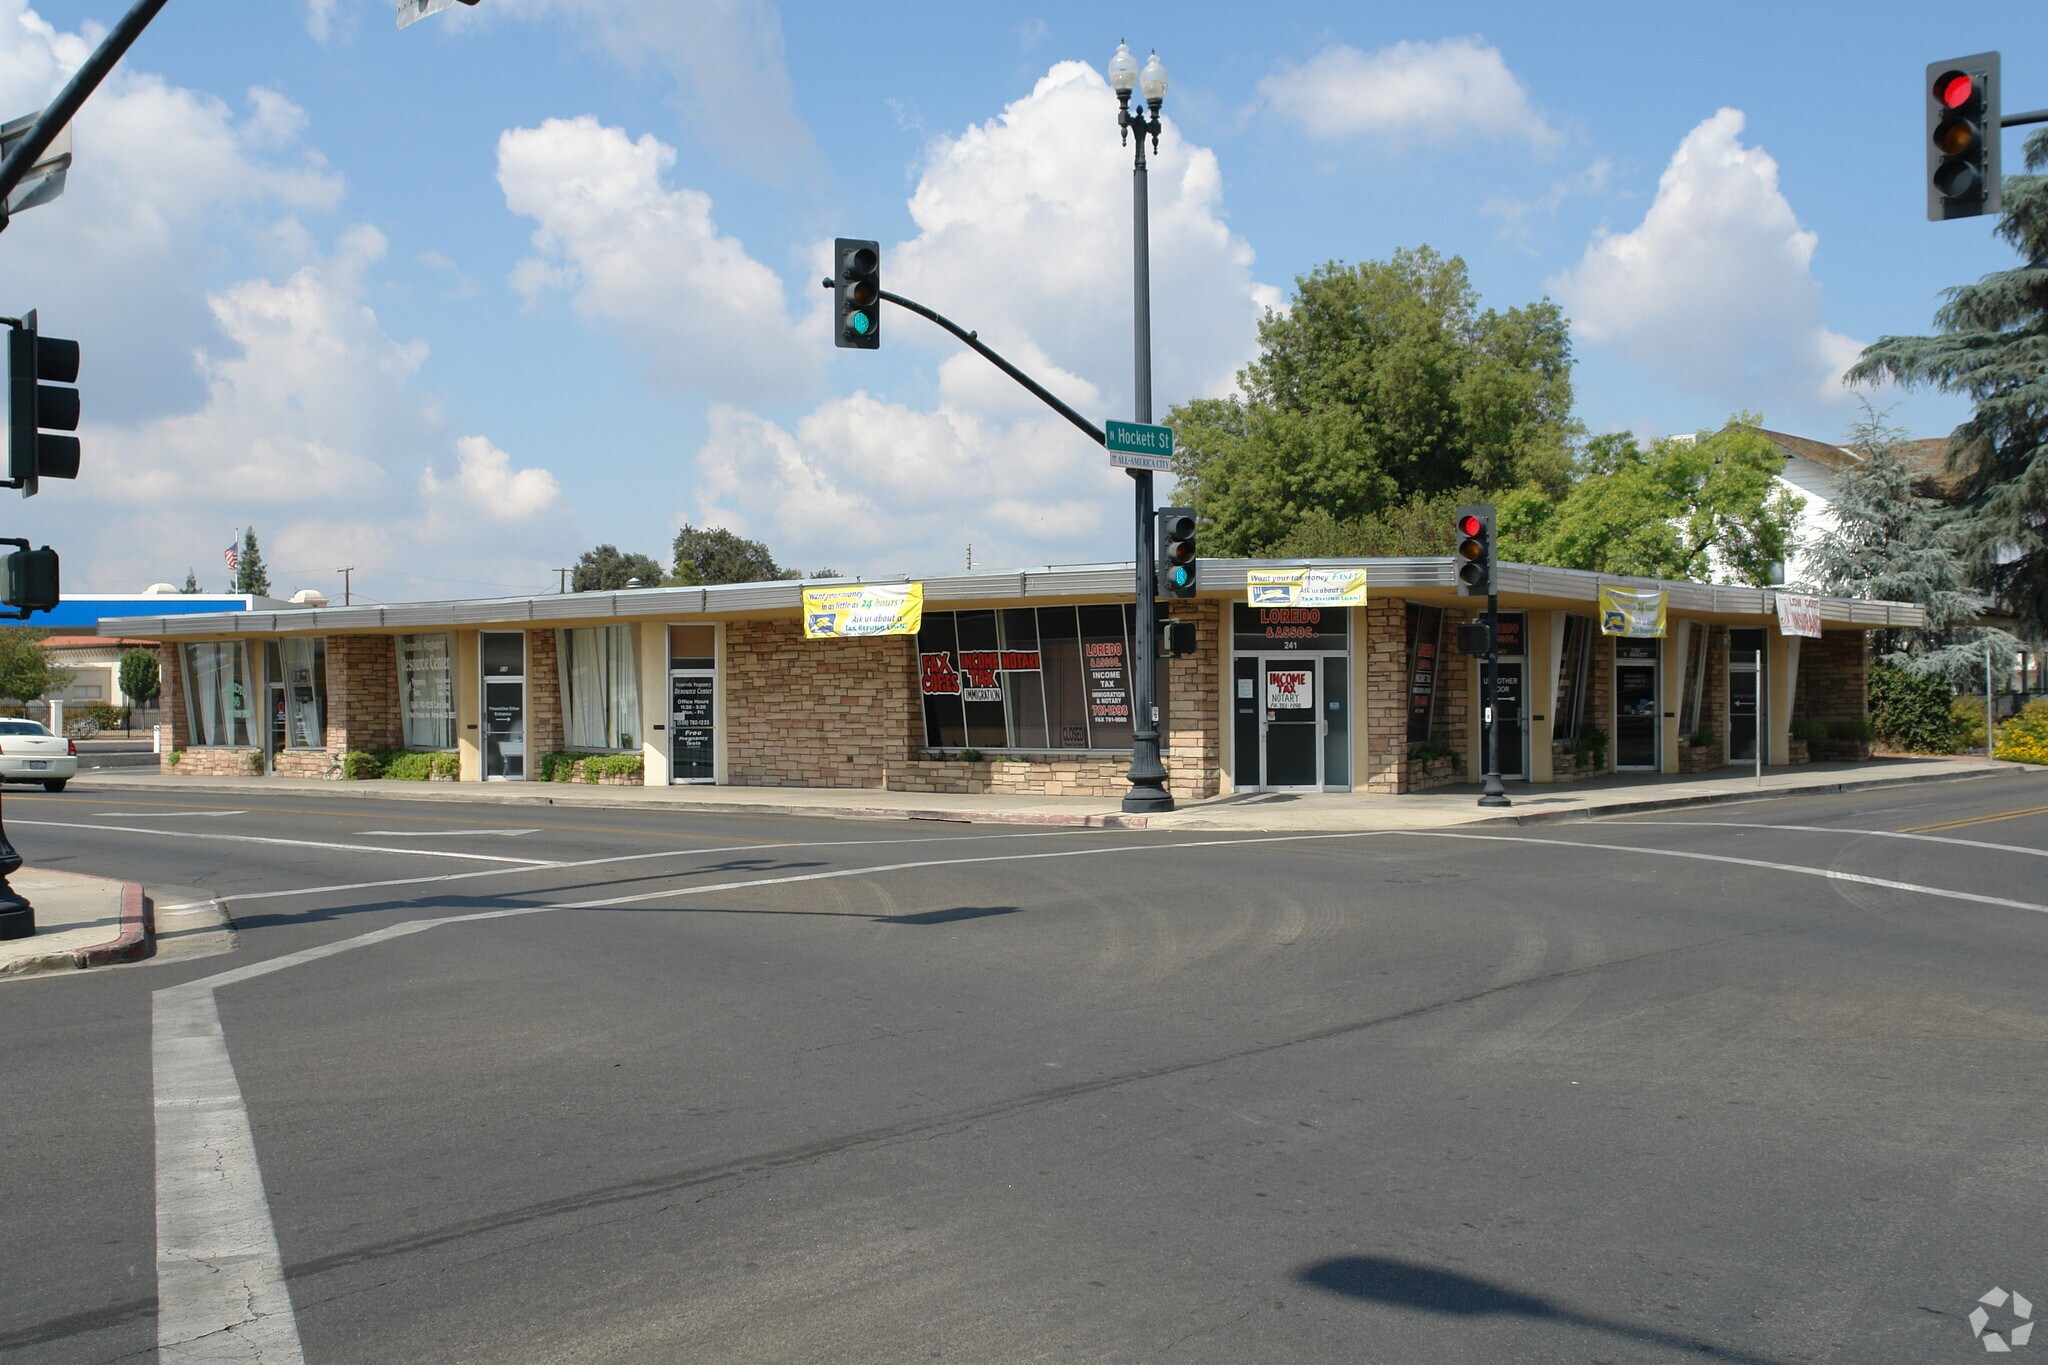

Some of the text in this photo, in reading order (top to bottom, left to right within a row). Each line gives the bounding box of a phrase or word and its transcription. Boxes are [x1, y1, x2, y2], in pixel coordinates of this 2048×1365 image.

[1109, 428, 1170, 449] N Hockett St
[1118, 456, 1169, 469] ALL-AMERICA CITY
[836, 601, 850, 609] little
[861, 599, 873, 609] 24
[852, 615, 863, 623] Ask
[873, 614, 895, 622] about
[1261, 609, 1320, 623] LOREDO
[1086, 643, 1122, 656] LOREDO
[429, 655, 450, 671] Center
[922, 653, 951, 674] FAX
[961, 652, 999, 669] INCOME
[1002, 652, 1040, 669] NOTARY
[968, 669, 997, 688] TAX
[1092, 671, 1121, 679] INCOME
[1270, 673, 1306, 686] INCOME
[966, 689, 1000, 700] IMMIGRATION
[1276, 684, 1297, 693] TAX
[1272, 693, 1300, 702] NOTARY
[1092, 704, 1129, 716] 781-1998
